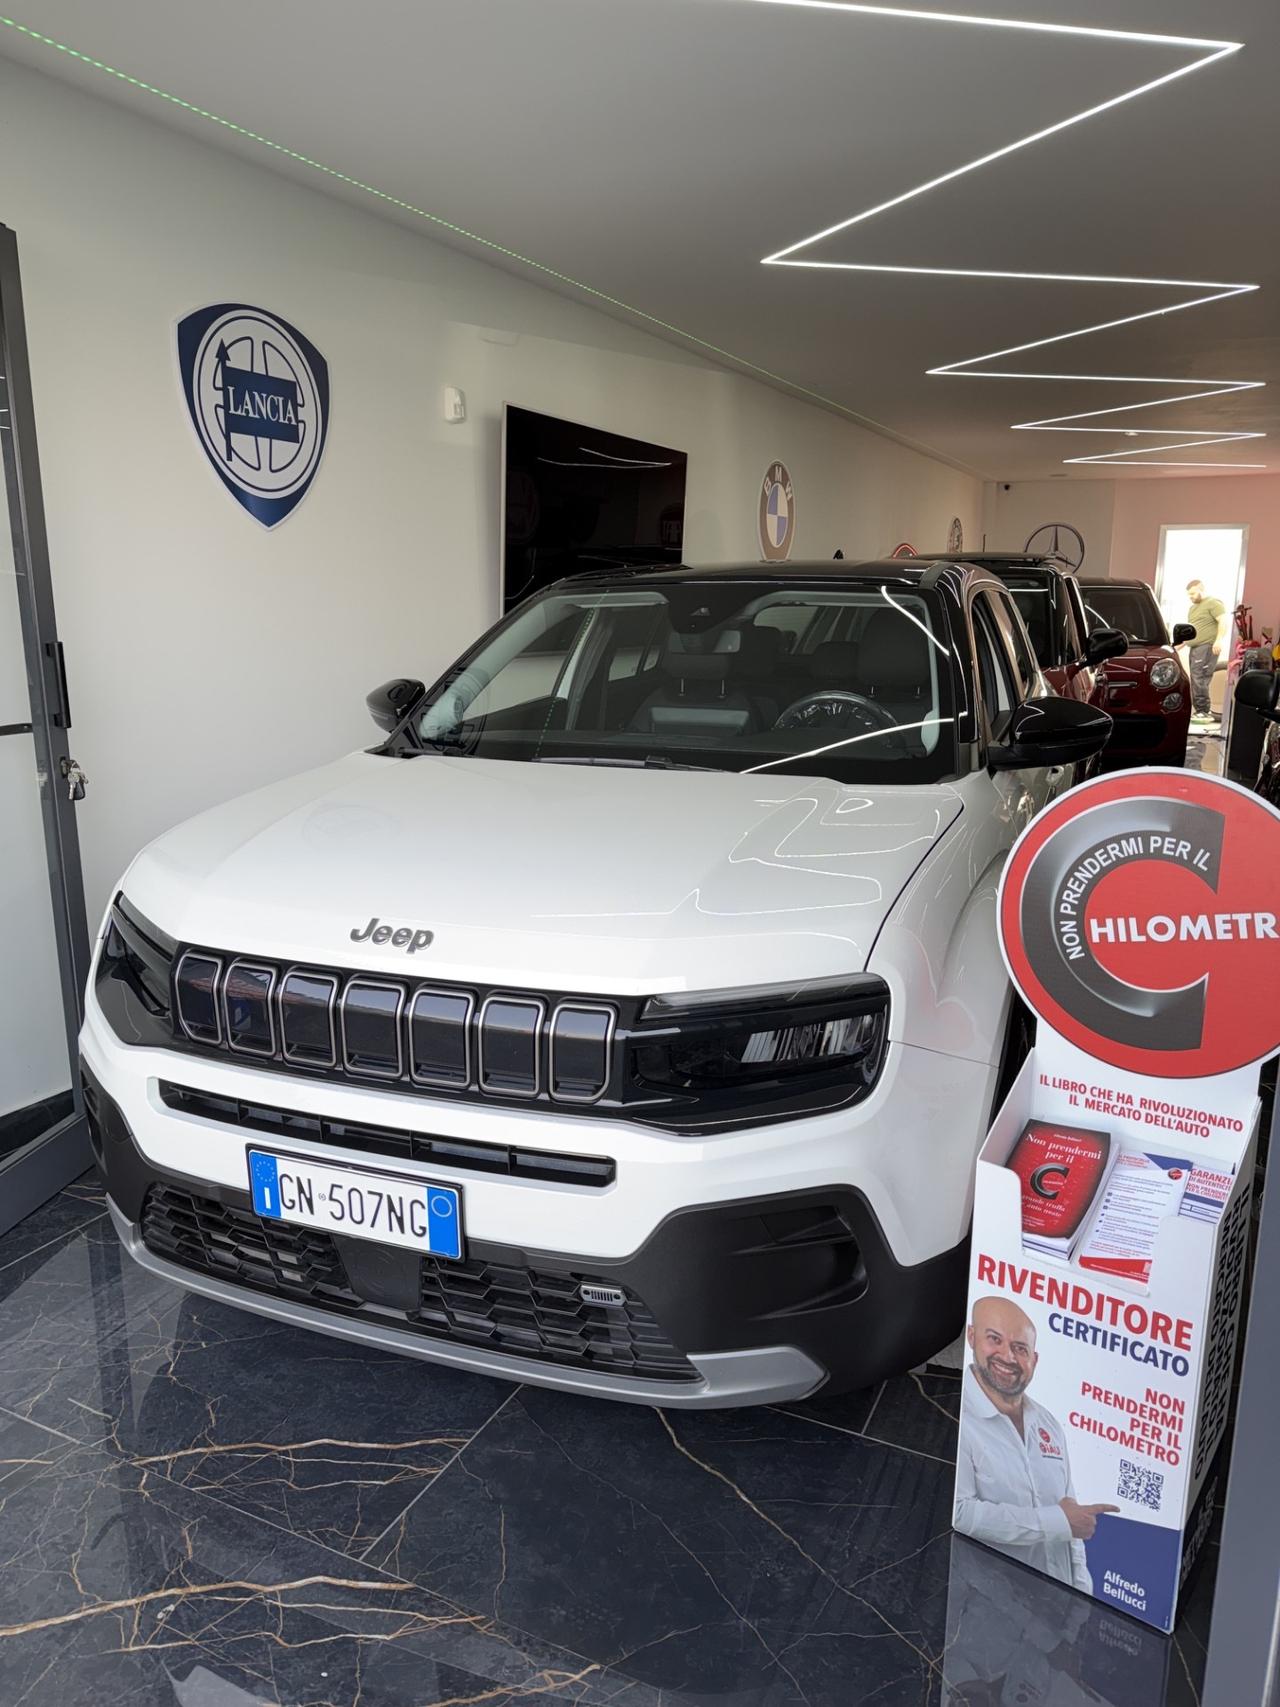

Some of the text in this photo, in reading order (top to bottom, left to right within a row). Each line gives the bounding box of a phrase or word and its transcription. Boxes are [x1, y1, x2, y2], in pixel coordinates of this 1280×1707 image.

[227, 386, 297, 426] LANCIA
[763, 465, 793, 501] BMW
[1060, 835, 1211, 961] NON PRENDERMI PER IL
[350, 918, 434, 954] Jeep
[1090, 912, 1280, 943] HILOMETR
[1039, 1074, 1243, 1132] IL LIBRO CHE HA RIVOLUZIONATO
[1068, 1094, 1210, 1138] IL MERCATO DELL'AUTO
[1027, 1133, 1046, 1146] Non
[1047, 1142, 1102, 1160] prendermi
[1045, 1151, 1074, 1164] per il
[1190, 1169, 1232, 1185] GARANZI
[279, 1173, 427, 1238] GN 507NG
[1227, 1215, 1249, 1319] LIBRO
[978, 1254, 1193, 1351] RIVENDITORE
[1049, 1312, 1189, 1377] CERTIFICATO
[1219, 1320, 1235, 1389] CHE
[1081, 1382, 1183, 1432] PRENDERMI
[1145, 1388, 1185, 1415] NON
[1069, 1411, 1180, 1466] CHILOMETRO
[1130, 1417, 1182, 1450] PER IL
[1103, 1582, 1147, 1611] Bellucci
[1104, 1570, 1145, 1597] Alfredo
